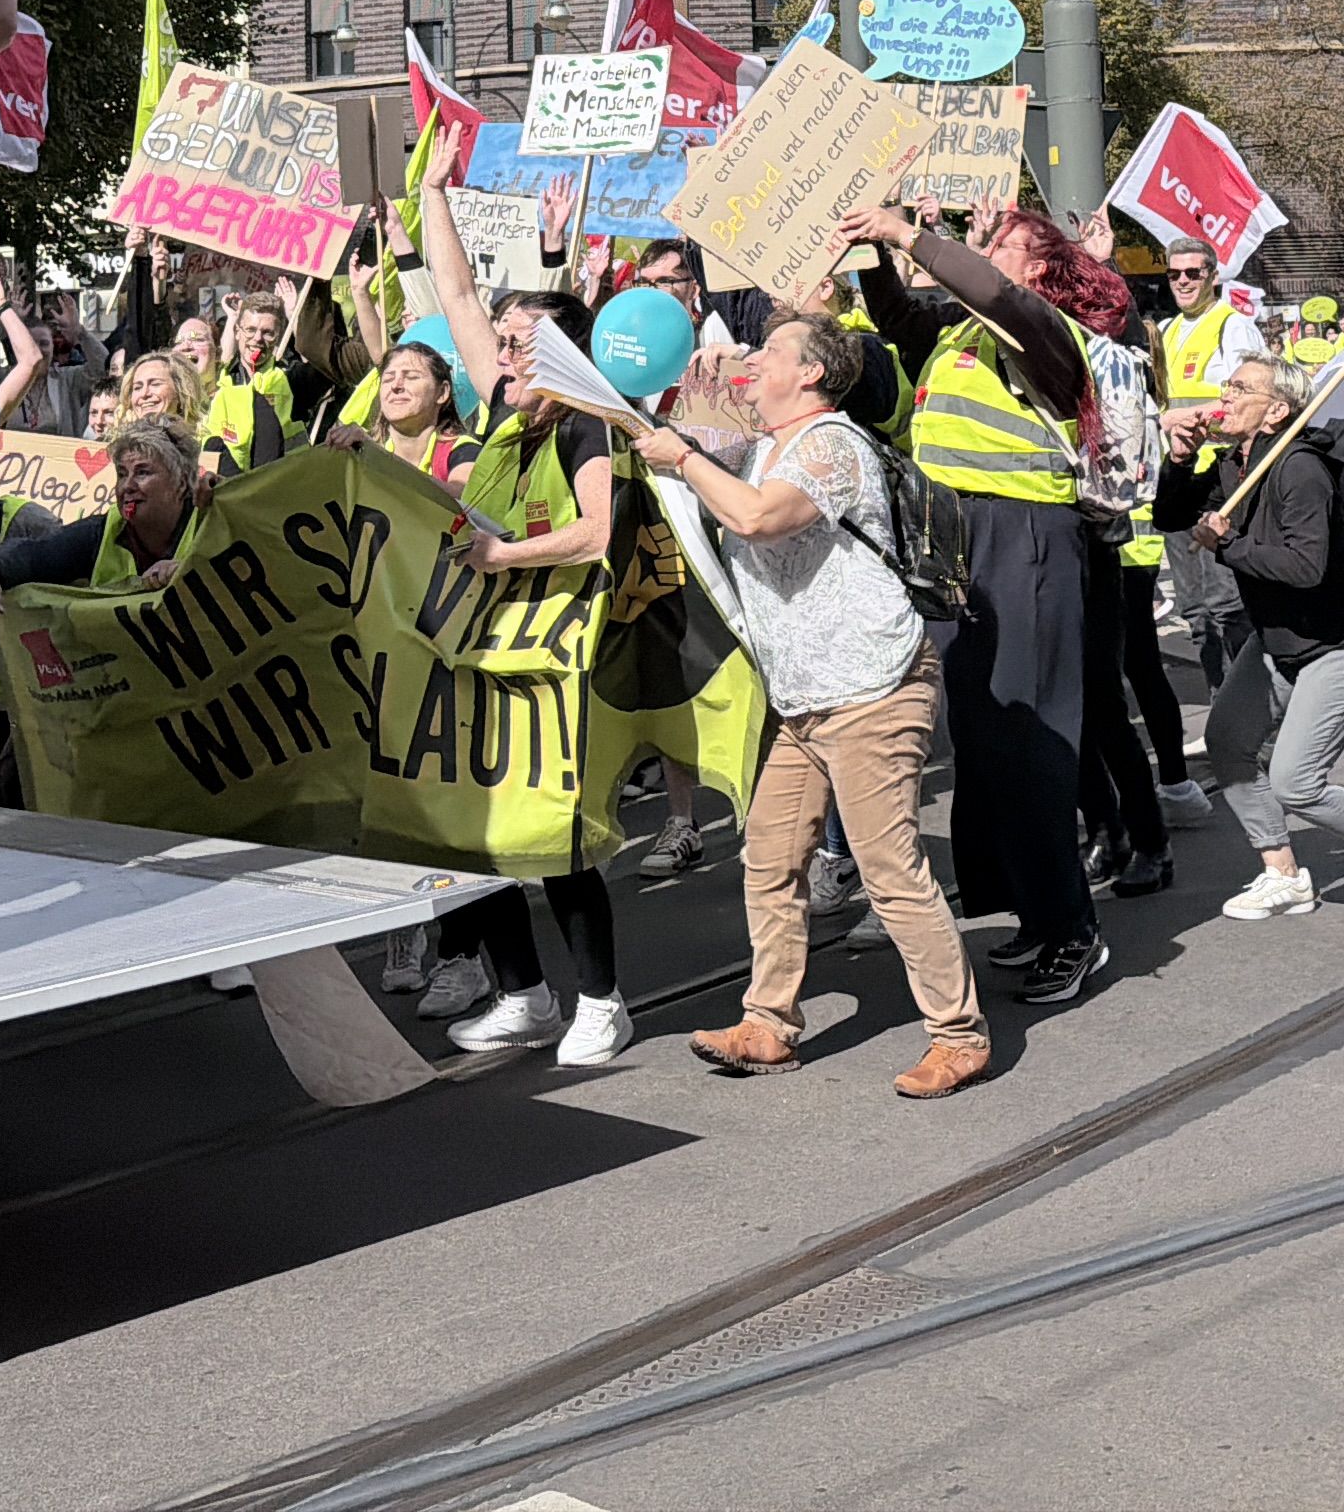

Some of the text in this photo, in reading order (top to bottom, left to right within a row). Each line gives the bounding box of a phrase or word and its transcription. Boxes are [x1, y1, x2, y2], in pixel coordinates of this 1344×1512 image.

[542, 60, 580, 85] Hier
[900, 18, 928, 34] die
[932, 22, 990, 40] Zukunft
[949, 44, 969, 58] in
[563, 87, 656, 113] Menschen,
[573, 114, 655, 139] Maschinen!
[714, 109, 772, 183] erkennen
[769, 62, 812, 112] jeden
[780, 130, 805, 163] und
[802, 71, 853, 134] machen
[142, 111, 302, 197] GEDULD
[737, 240, 769, 268] ihn
[828, 87, 880, 161] erkennt
[112, 172, 354, 271] ABGEFÜHRT
[772, 223, 830, 290] endlich
[826, 166, 875, 222] unseren
[1160, 165, 1235, 246] ver.di
[115, 540, 296, 688] WIR
[157, 654, 331, 795] WIR
